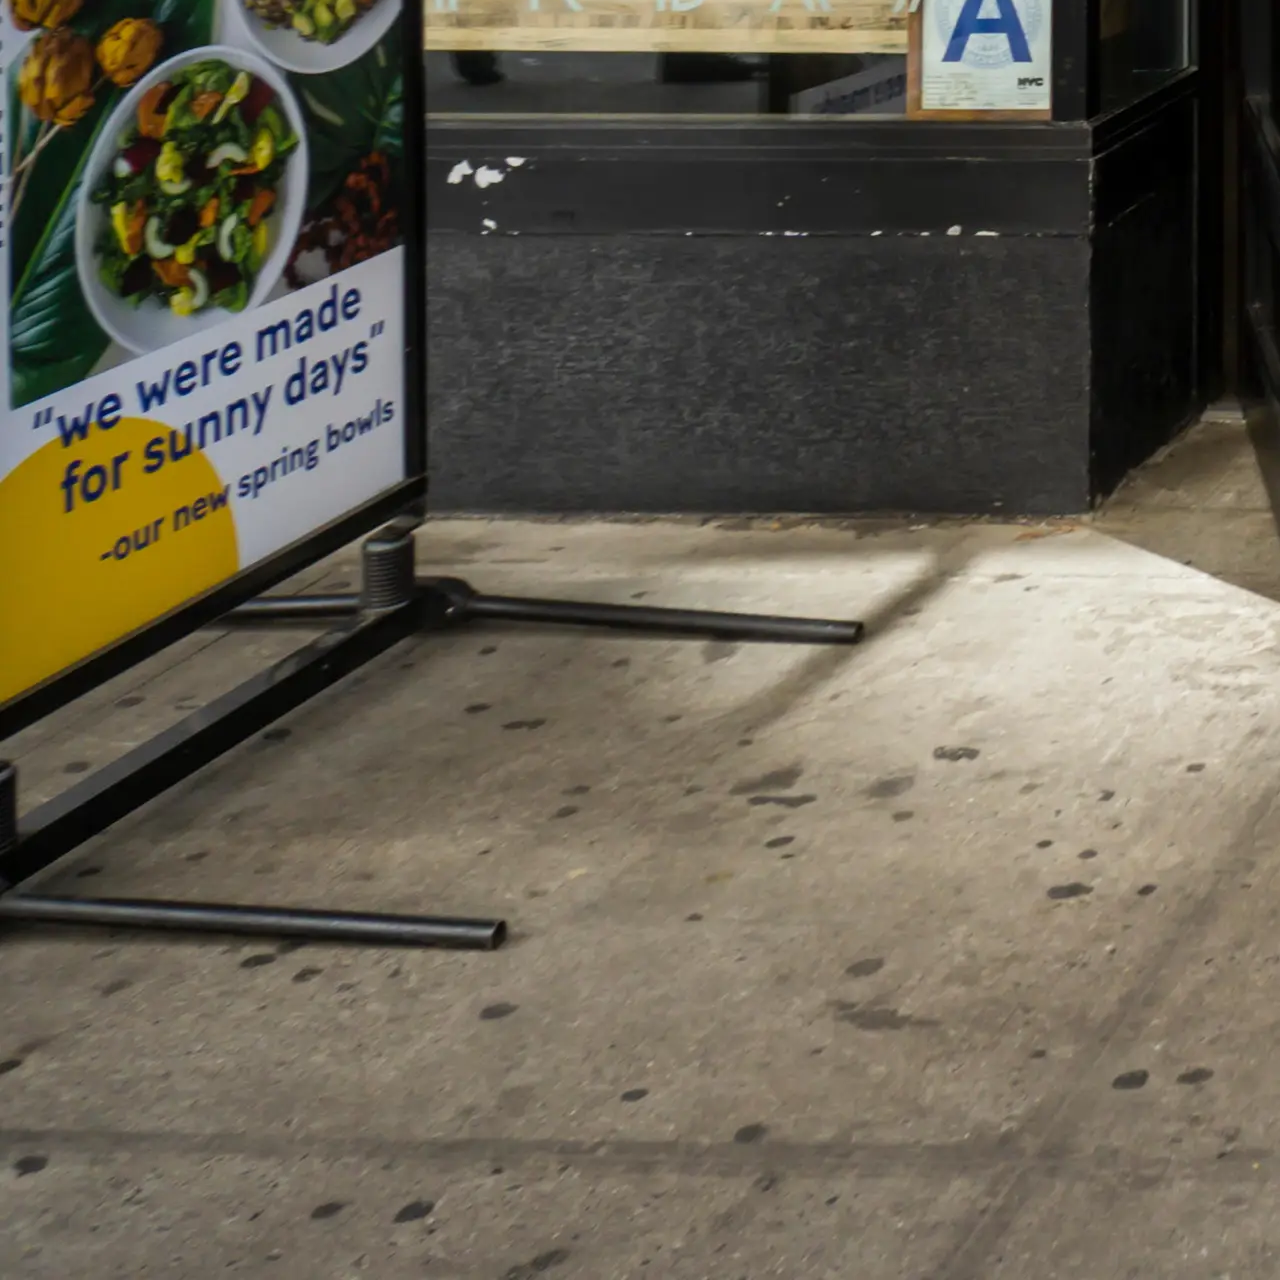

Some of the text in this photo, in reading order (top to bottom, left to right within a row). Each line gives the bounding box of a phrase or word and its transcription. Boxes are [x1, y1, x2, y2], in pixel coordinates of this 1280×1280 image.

[136, 340, 242, 413] were
[255, 283, 362, 362] made
[60, 450, 132, 514] for
[143, 384, 274, 475] sunny
[173, 484, 229, 533] new
[238, 438, 321, 500] spring
[325, 398, 395, 453] bowls
